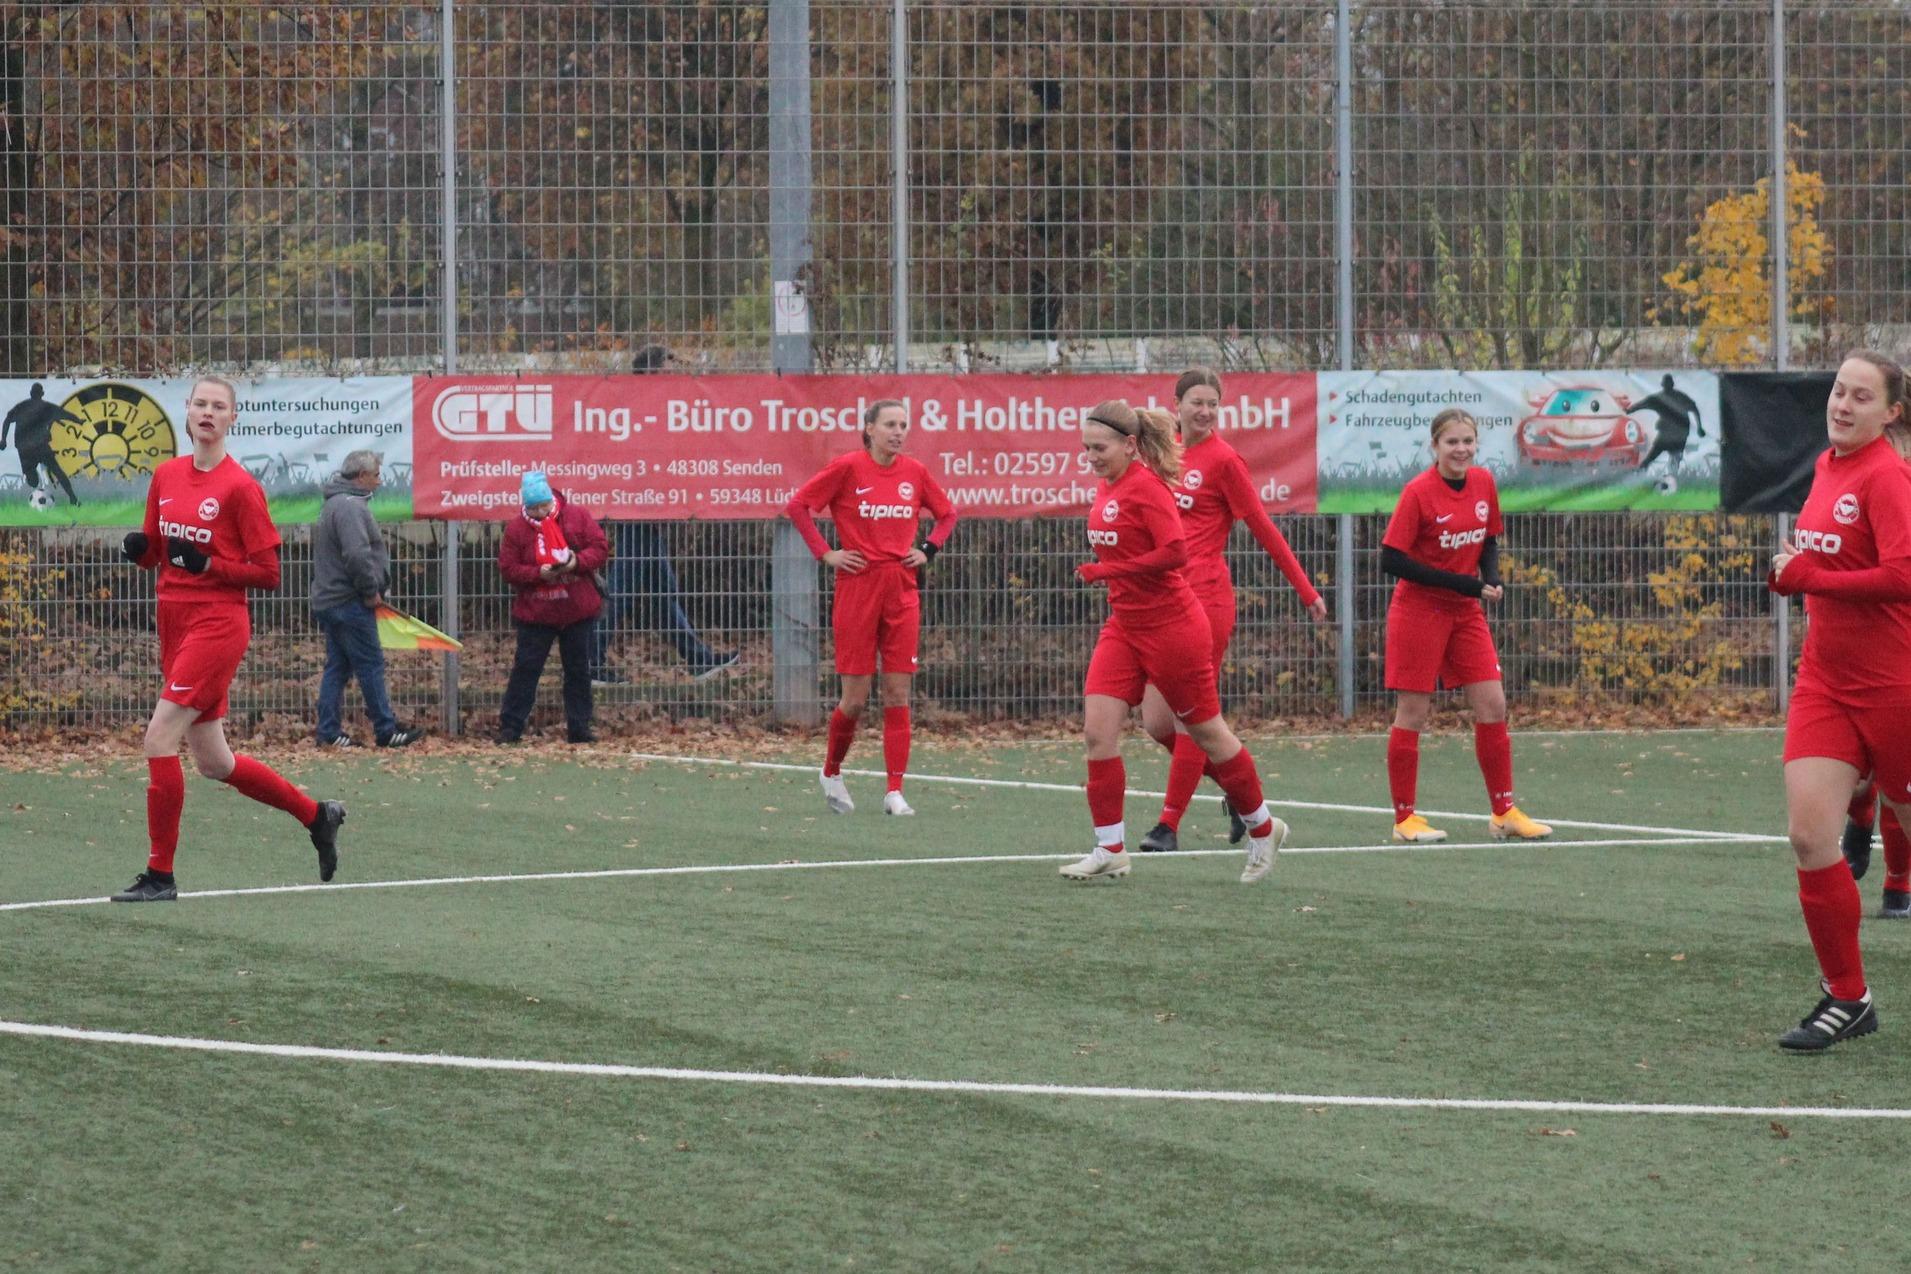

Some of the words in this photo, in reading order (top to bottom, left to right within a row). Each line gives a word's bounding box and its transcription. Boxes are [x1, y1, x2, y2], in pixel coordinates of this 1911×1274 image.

[235, 397, 379, 415] ptuntersuchungen
[1345, 390, 1482, 407] Schadengutachten
[101, 401, 118, 418] 12
[124, 405, 139, 424] 11
[437, 384, 552, 435] GTÜ
[667, 398, 753, 432] Büro
[760, 396, 910, 432] Troschl
[920, 398, 948, 431] &
[66, 424, 82, 440] 2
[137, 420, 156, 441] 10
[227, 420, 402, 438] timerbegutachtungen
[531, 460, 632, 479] Messingweg
[636, 460, 647, 476] 3
[666, 459, 719, 476] 48308
[723, 458, 783, 476] Senden
[939, 450, 989, 475] Tel.:
[994, 452, 1070, 475] 02597
[441, 488, 523, 510] Zweigstel
[611, 488, 665, 505] Straße
[668, 488, 688, 505] 91
[710, 488, 761, 505] 59348
[946, 480, 1097, 504] www.trosche
[858, 500, 913, 520] tipico
